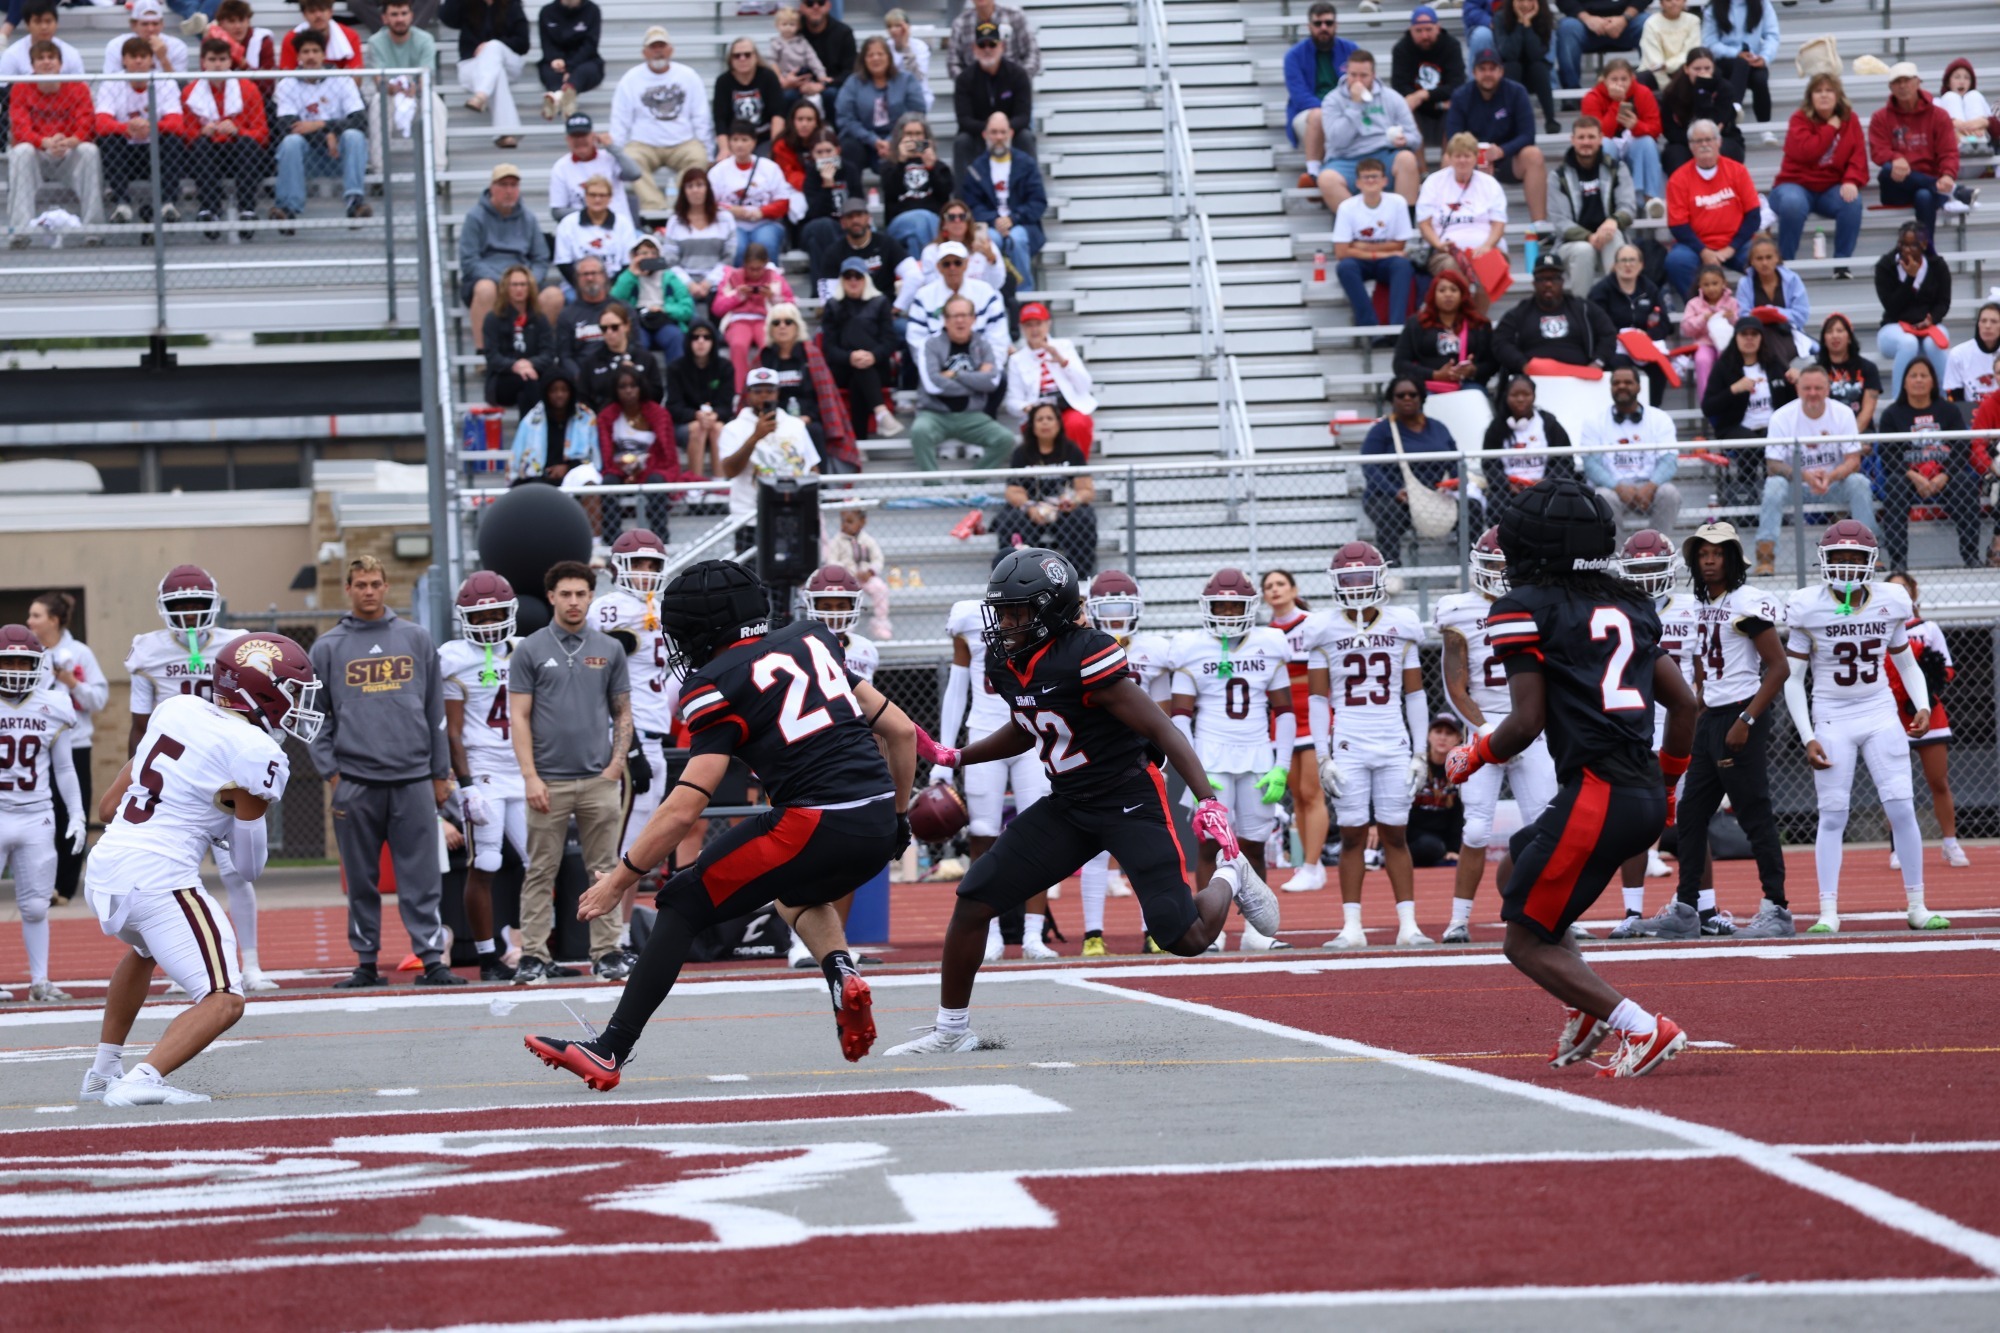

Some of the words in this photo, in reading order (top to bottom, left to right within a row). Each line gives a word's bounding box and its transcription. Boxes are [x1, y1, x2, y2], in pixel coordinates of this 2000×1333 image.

[600, 606, 618, 623] 53
[1761, 602, 1776, 621] 24
[1825, 622, 1887, 638] SPARTANS
[166, 662, 215, 677] SPARTA
[1203, 659, 1266, 675] SPRTANS
[1589, 606, 1646, 712] 2
[1832, 639, 1882, 687] 35
[752, 633, 864, 746] 24
[1343, 652, 1392, 706] 23
[1225, 677, 1250, 720] 0
[123, 733, 186, 825] 5
[263, 760, 279, 789] 5
